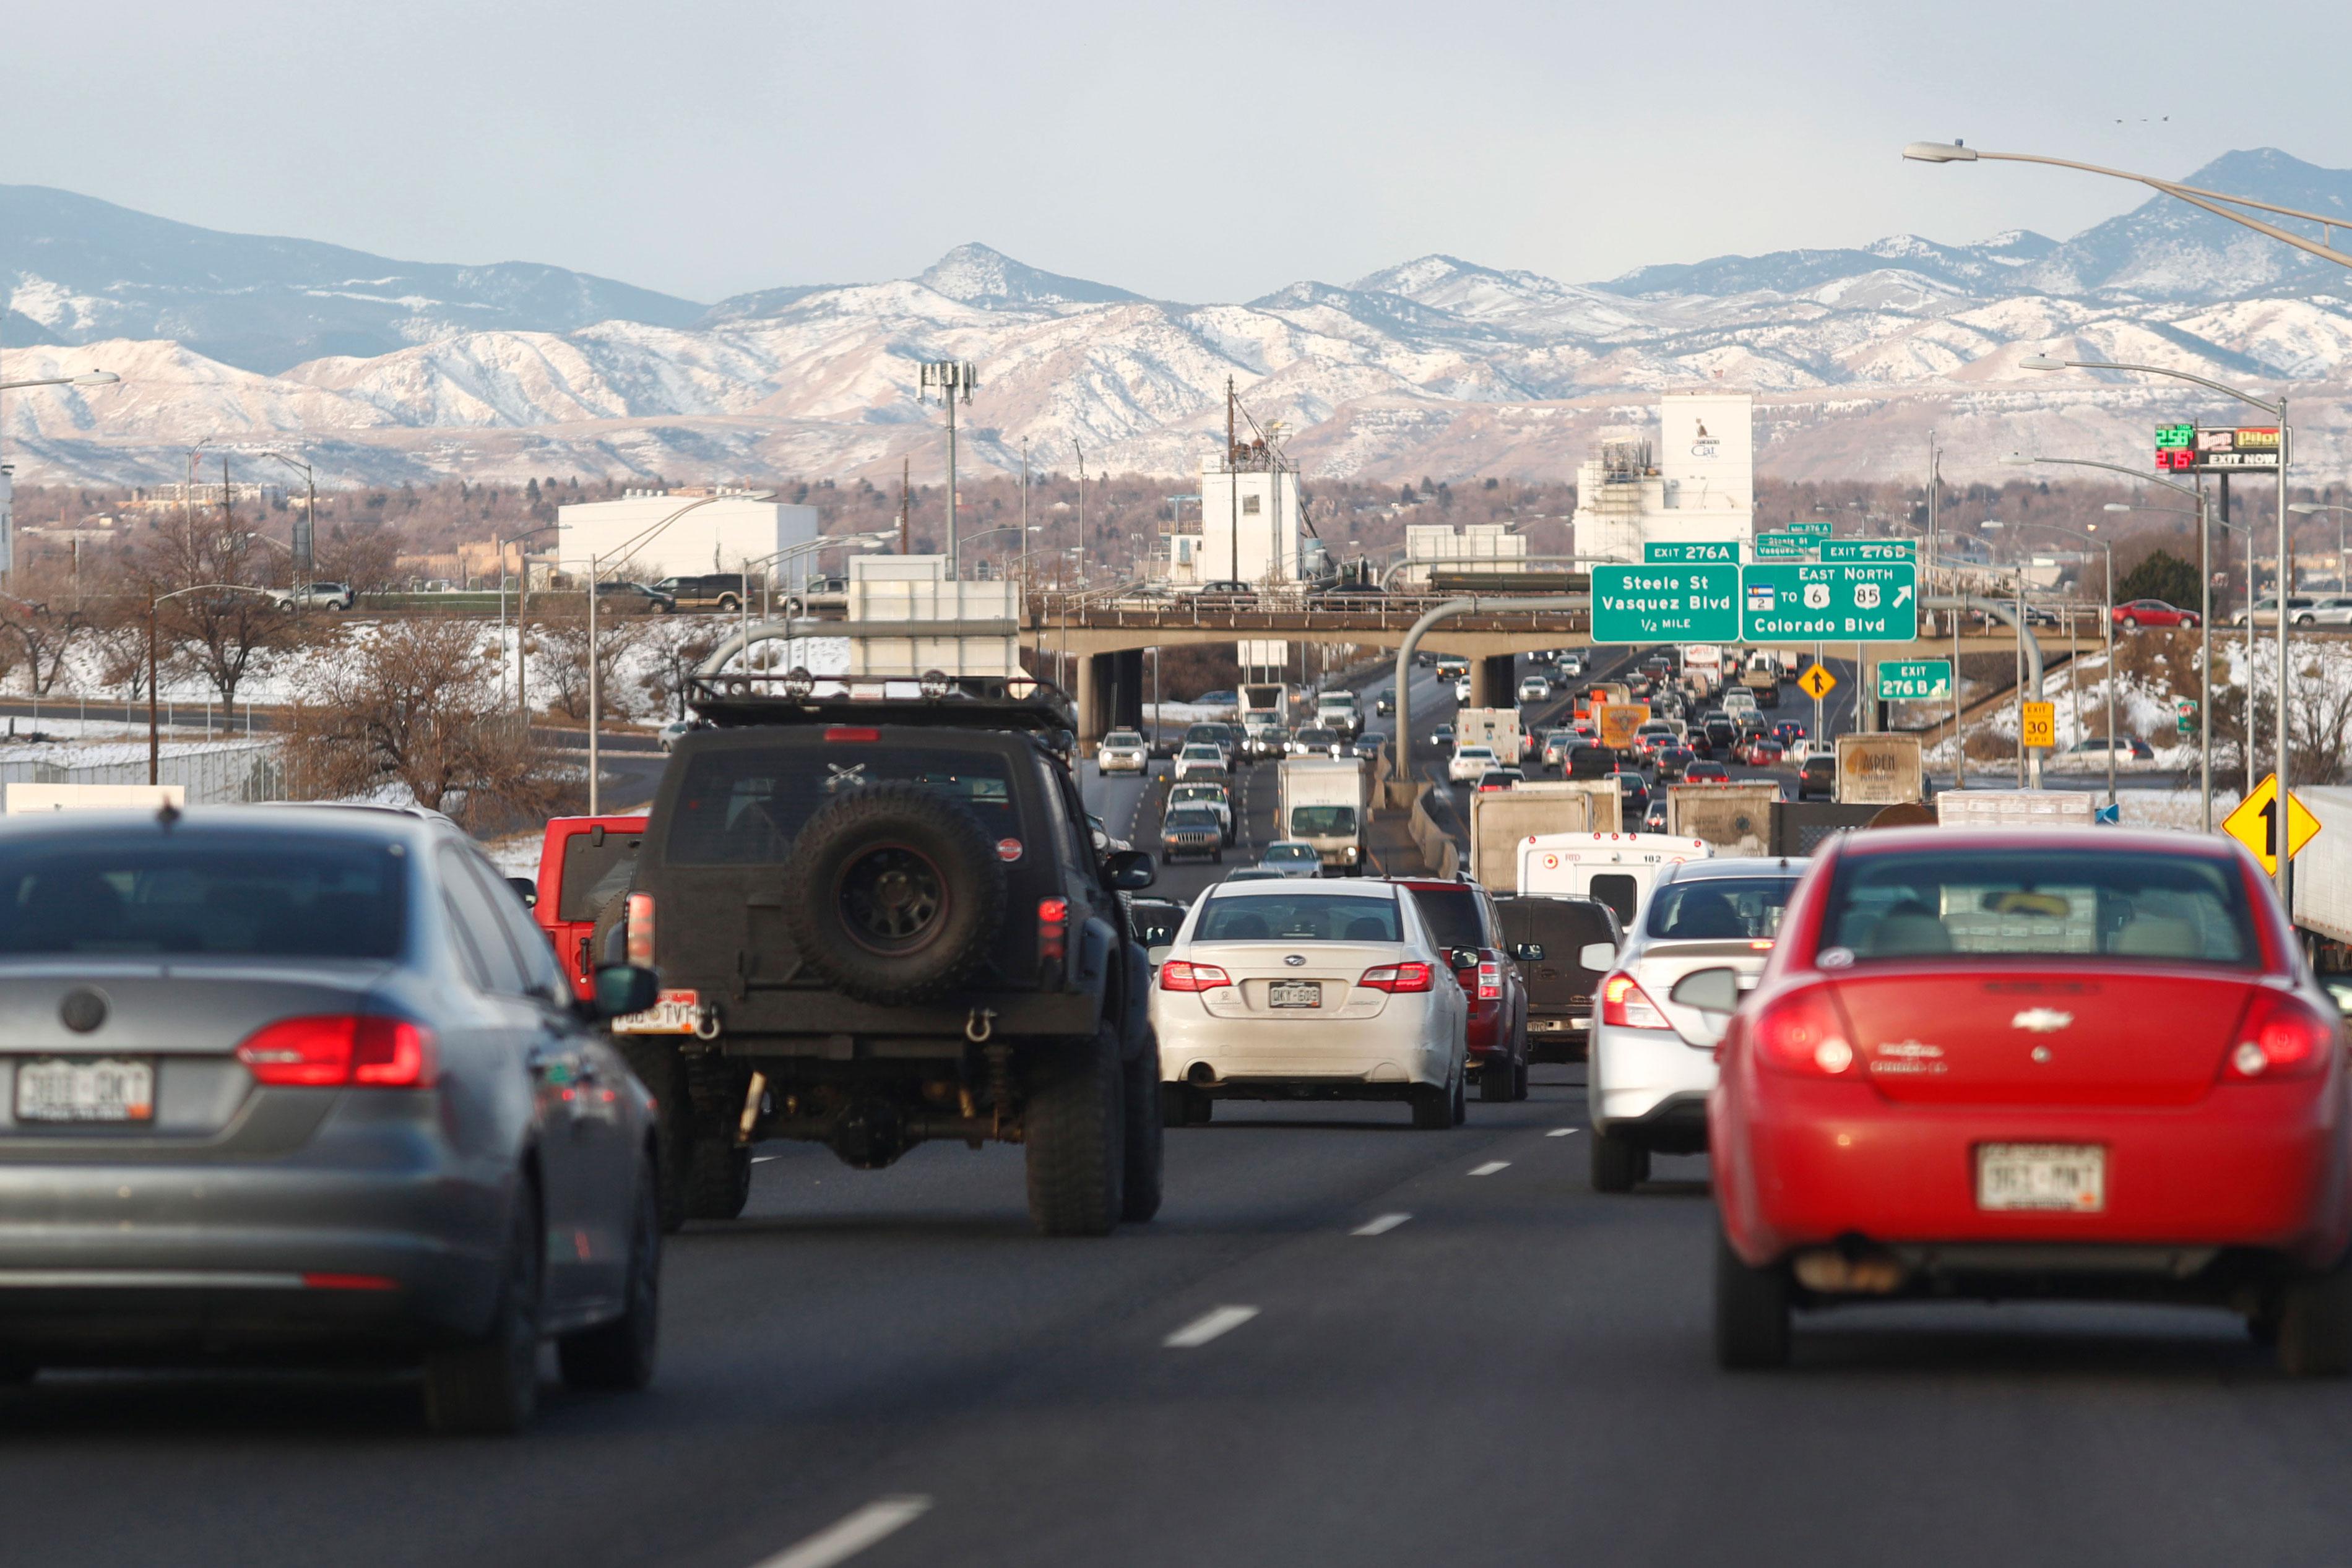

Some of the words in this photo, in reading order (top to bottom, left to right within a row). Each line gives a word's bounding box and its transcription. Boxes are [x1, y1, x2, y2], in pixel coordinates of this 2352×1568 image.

[2208, 454, 2241, 463] EXIT
[2244, 454, 2277, 463] NOW
[1654, 548, 1679, 557] EXIT
[1685, 546, 1730, 559] 276A
[1830, 547, 1856, 556] EXIT
[1799, 567, 1835, 580] EAST
[1844, 567, 1893, 580] NORTH
[1623, 576, 1679, 590] Steele
[1690, 575, 1708, 590] St
[1602, 596, 1679, 613] Vasquez
[1690, 595, 1730, 610] Blvd
[1758, 599, 1765, 608] 2
[1781, 592, 1797, 602] TO
[1812, 590, 1822, 603] 6
[1857, 590, 1878, 603] 85
[1662, 619, 1691, 628] MILE
[1755, 619, 1836, 632] Colorado
[1844, 619, 1885, 631] Blvd
[1901, 666, 1927, 677] EXIT
[1883, 680, 1914, 696] 276
[1917, 680, 1927, 694] B
[2027, 721, 2047, 734] 30
